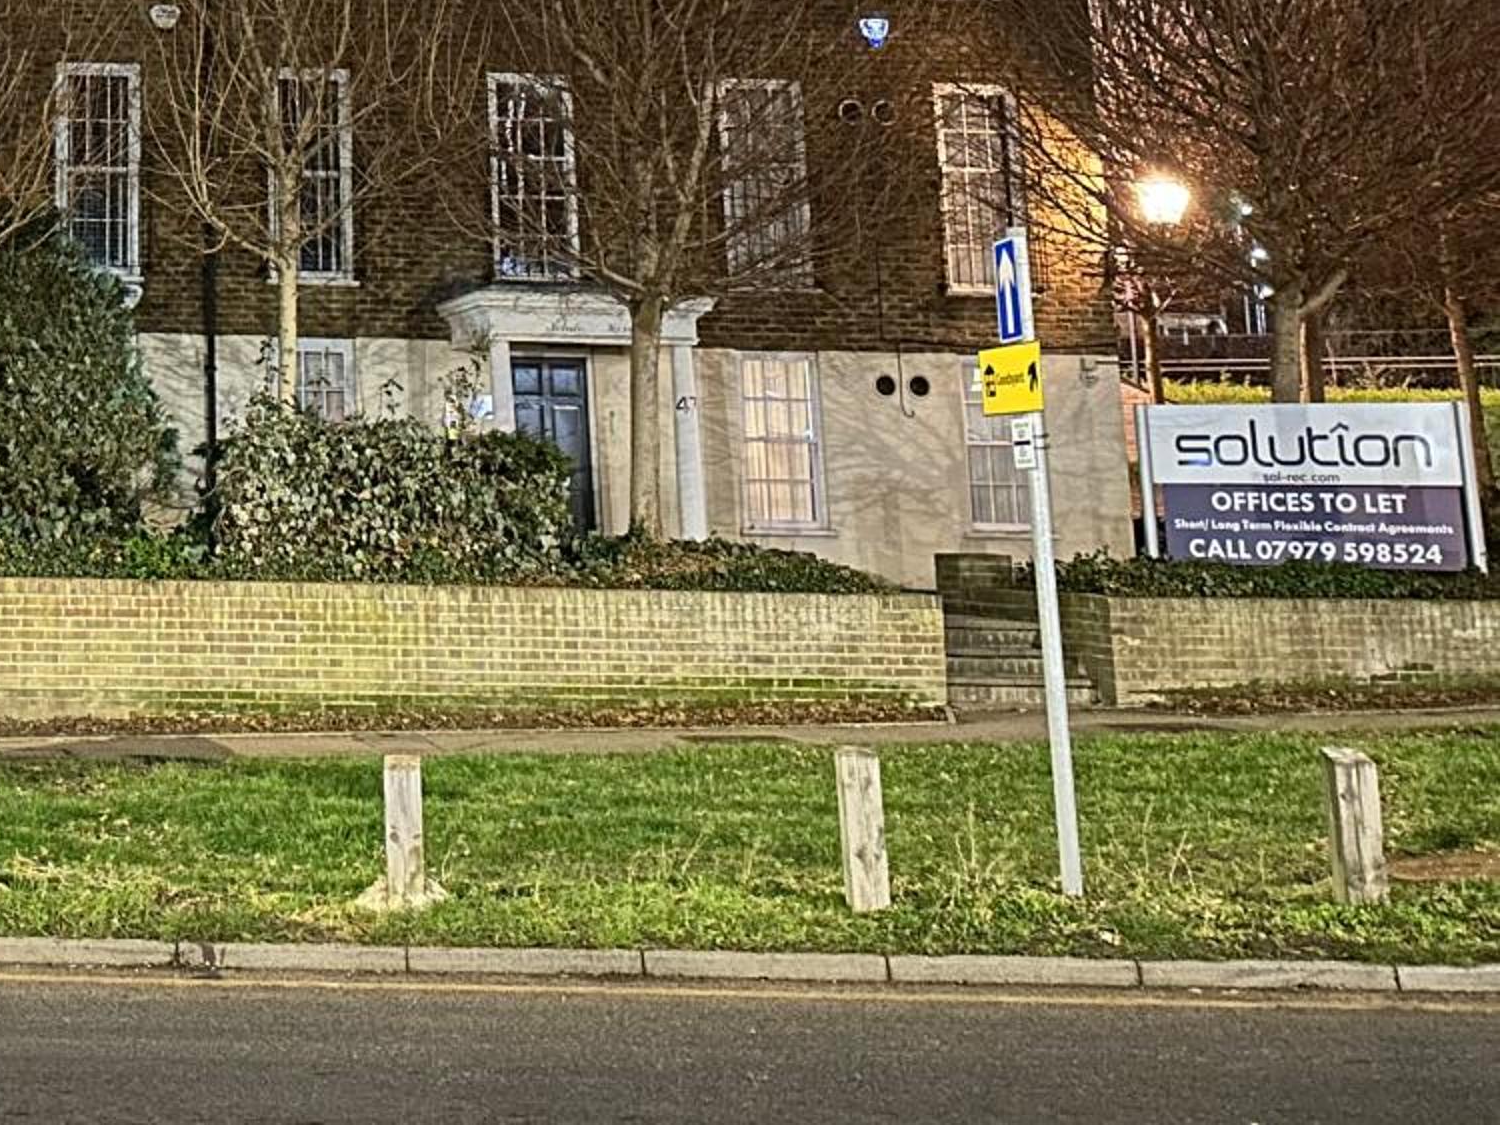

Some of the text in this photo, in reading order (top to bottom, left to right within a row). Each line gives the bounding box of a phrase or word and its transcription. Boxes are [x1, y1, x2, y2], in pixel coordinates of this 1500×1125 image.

[675, 396, 698, 414] 47
[1211, 490, 1407, 515] OFFICES TO LET
[1211, 518, 1240, 533] Long
[1241, 518, 1272, 531] Term
[1273, 520, 1322, 532] Flexible
[1323, 520, 1376, 533] Contract
[1378, 521, 1454, 535] Agreements
[1189, 538, 1443, 565] CALL 07979 598524
